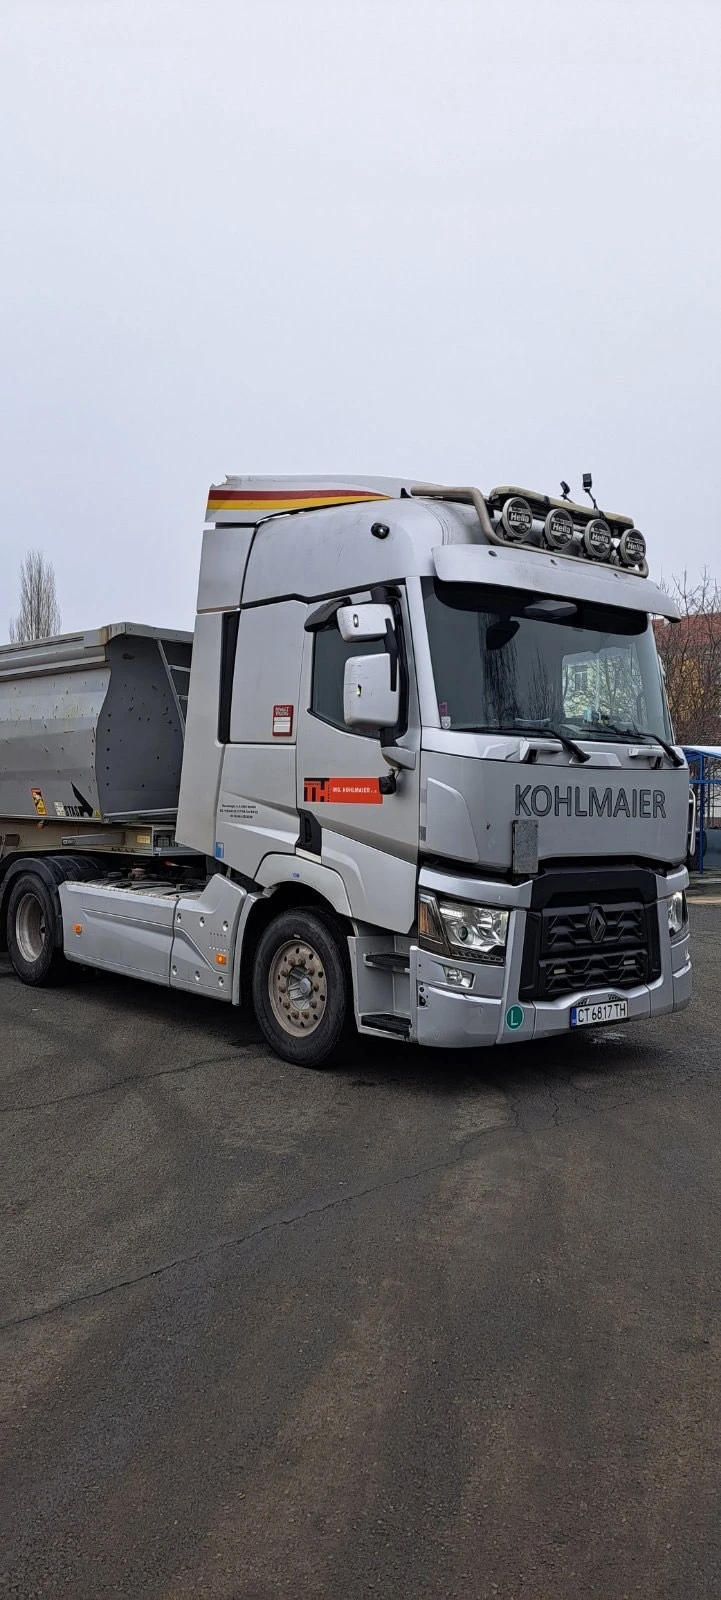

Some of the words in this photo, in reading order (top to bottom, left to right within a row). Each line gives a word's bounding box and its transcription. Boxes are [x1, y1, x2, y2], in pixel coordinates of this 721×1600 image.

[510, 513, 530, 523] Hella
[552, 523, 571, 534] Hella
[592, 533, 609, 543] Hella
[627, 542, 643, 552] Hella
[342, 786, 370, 794] KOHLMAIER
[514, 784, 667, 819] KOHLMAIER
[578, 1007, 590, 1022] CT
[592, 1005, 613, 1021] 6817
[614, 1001, 626, 1017] TH
[510, 1009, 518, 1026] L
